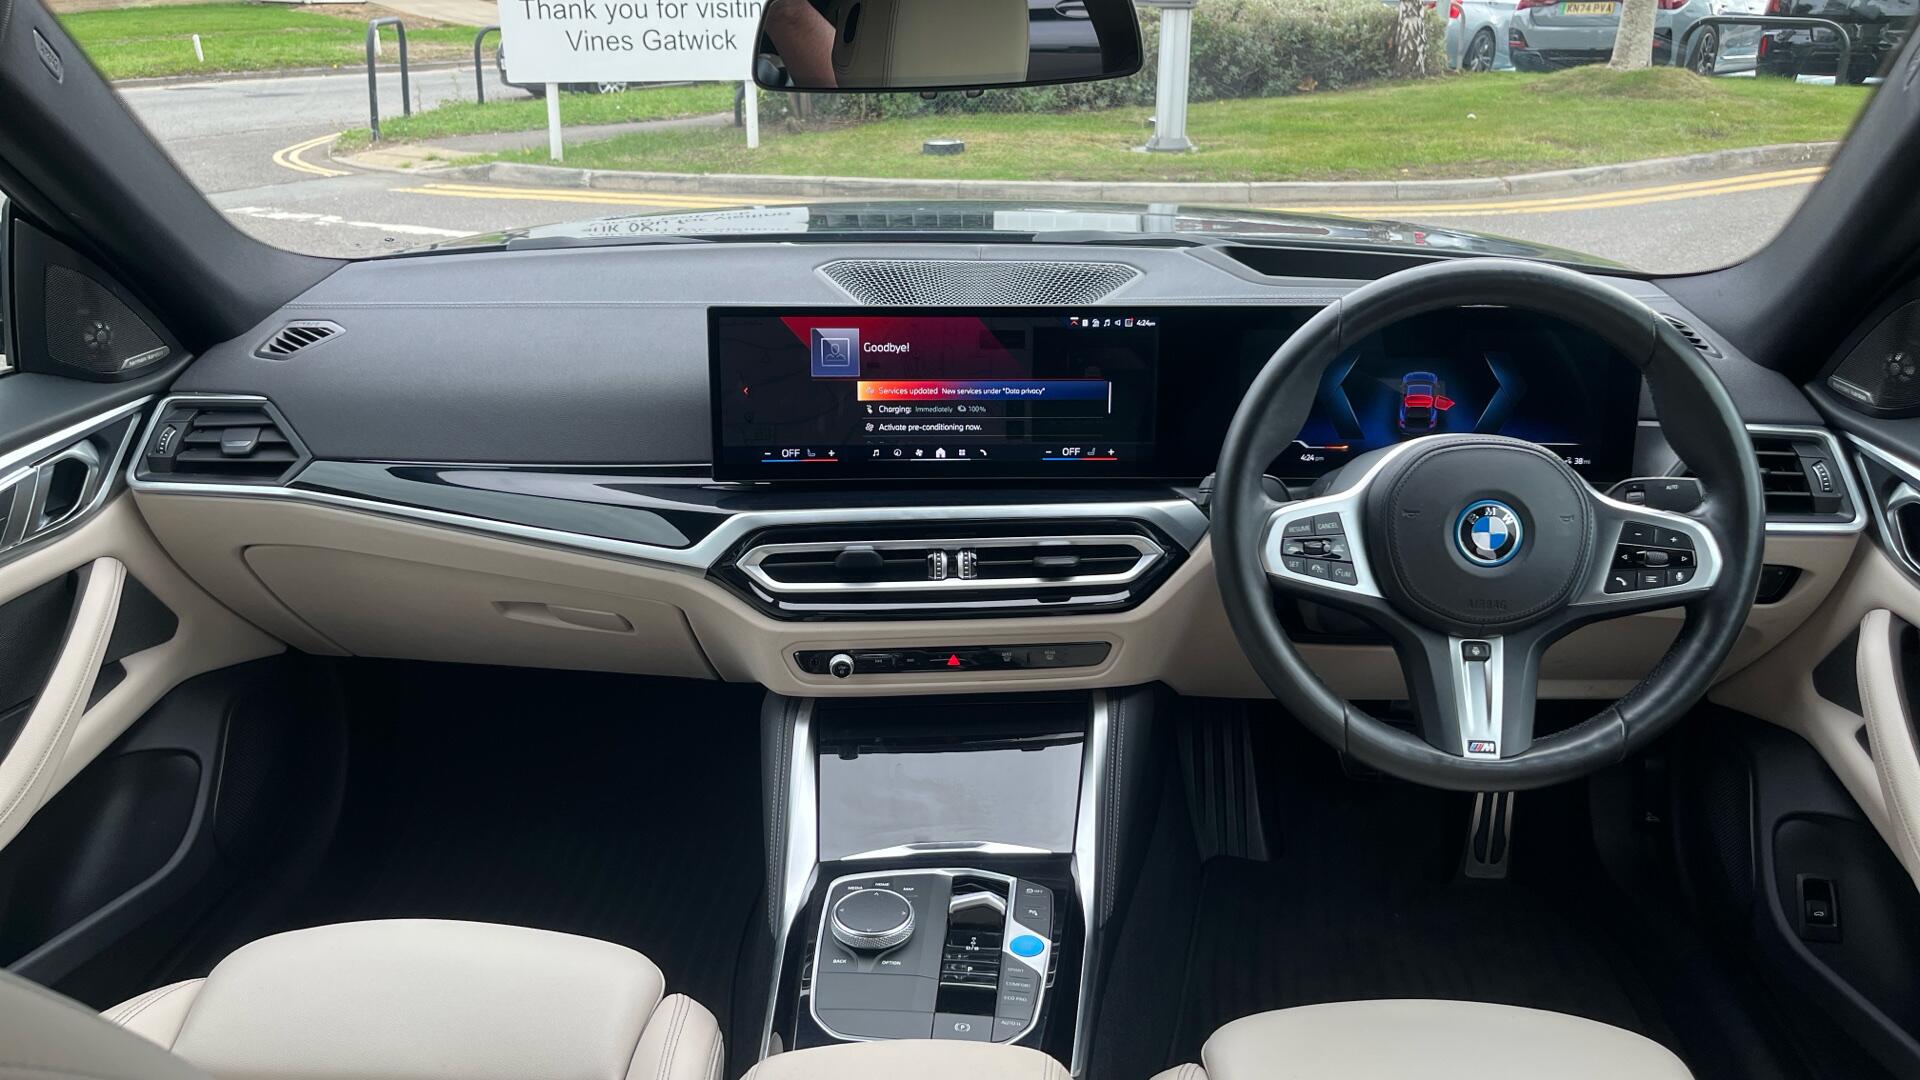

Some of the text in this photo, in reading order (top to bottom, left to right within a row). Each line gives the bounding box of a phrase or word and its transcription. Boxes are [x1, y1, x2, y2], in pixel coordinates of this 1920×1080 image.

[519, 0, 763, 25] Thank you for visitin
[565, 29, 738, 51] Vines Gatwick
[863, 342, 910, 354] Goodbye!
[878, 387, 908, 395] Services
[909, 387, 939, 397] updated
[941, 387, 956, 395] New
[957, 387, 982, 395] services
[983, 387, 1001, 395] under
[878, 405, 987, 415] Charging: Immediately 100%
[878, 423, 983, 434] Activate pre-conditioning now.
[781, 448, 800, 458] OFF
[1062, 447, 1081, 457] OFF
[1317, 522, 1339, 530] CANCEL
